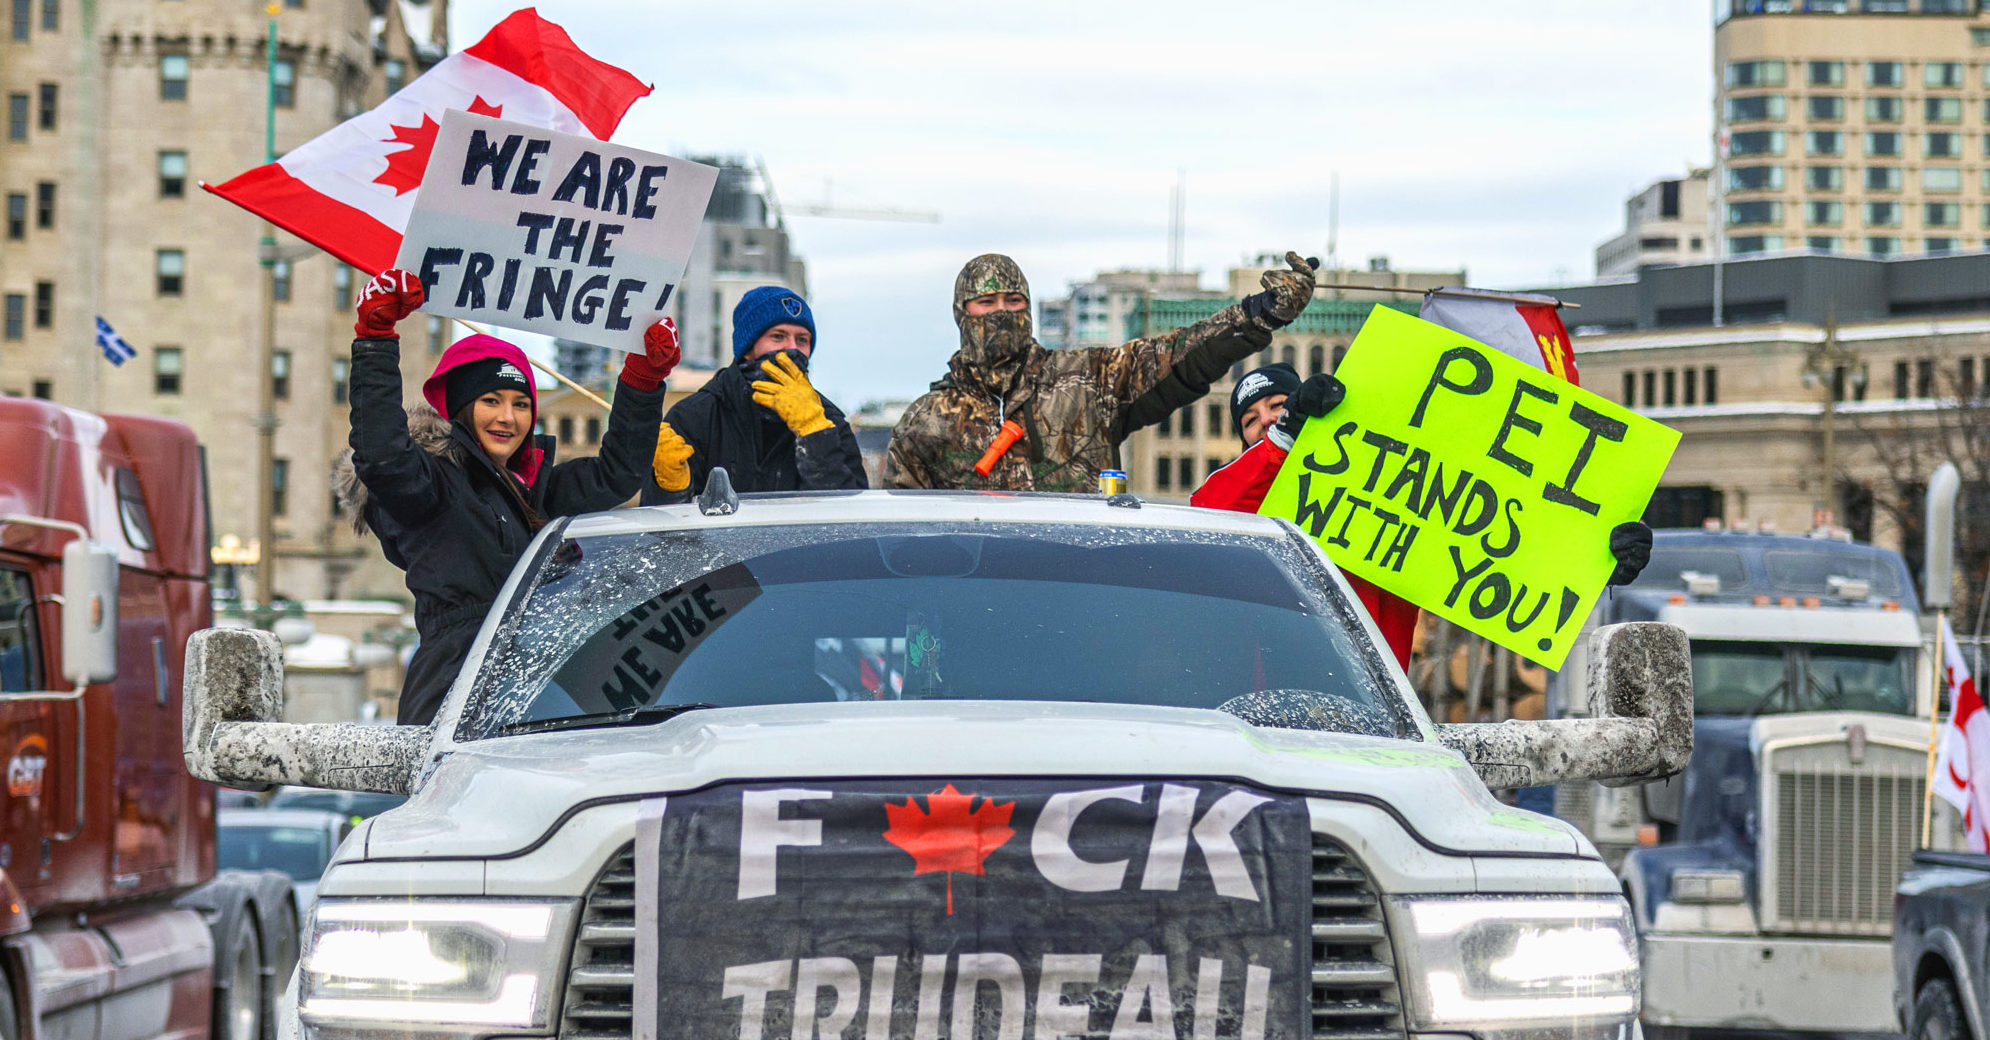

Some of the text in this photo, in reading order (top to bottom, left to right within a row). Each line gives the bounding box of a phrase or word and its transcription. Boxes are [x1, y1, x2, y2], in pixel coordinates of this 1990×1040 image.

[461, 130, 668, 219] WE ARE
[517, 211, 624, 268] THE
[1408, 346, 1629, 517] PEI
[1295, 472, 1420, 572] WITH
[1302, 421, 1523, 559] STANDS
[1444, 545, 1580, 652] YOU!
[737, 783, 1275, 902] FCK
[722, 952, 1272, 1040] TRUDEAU
